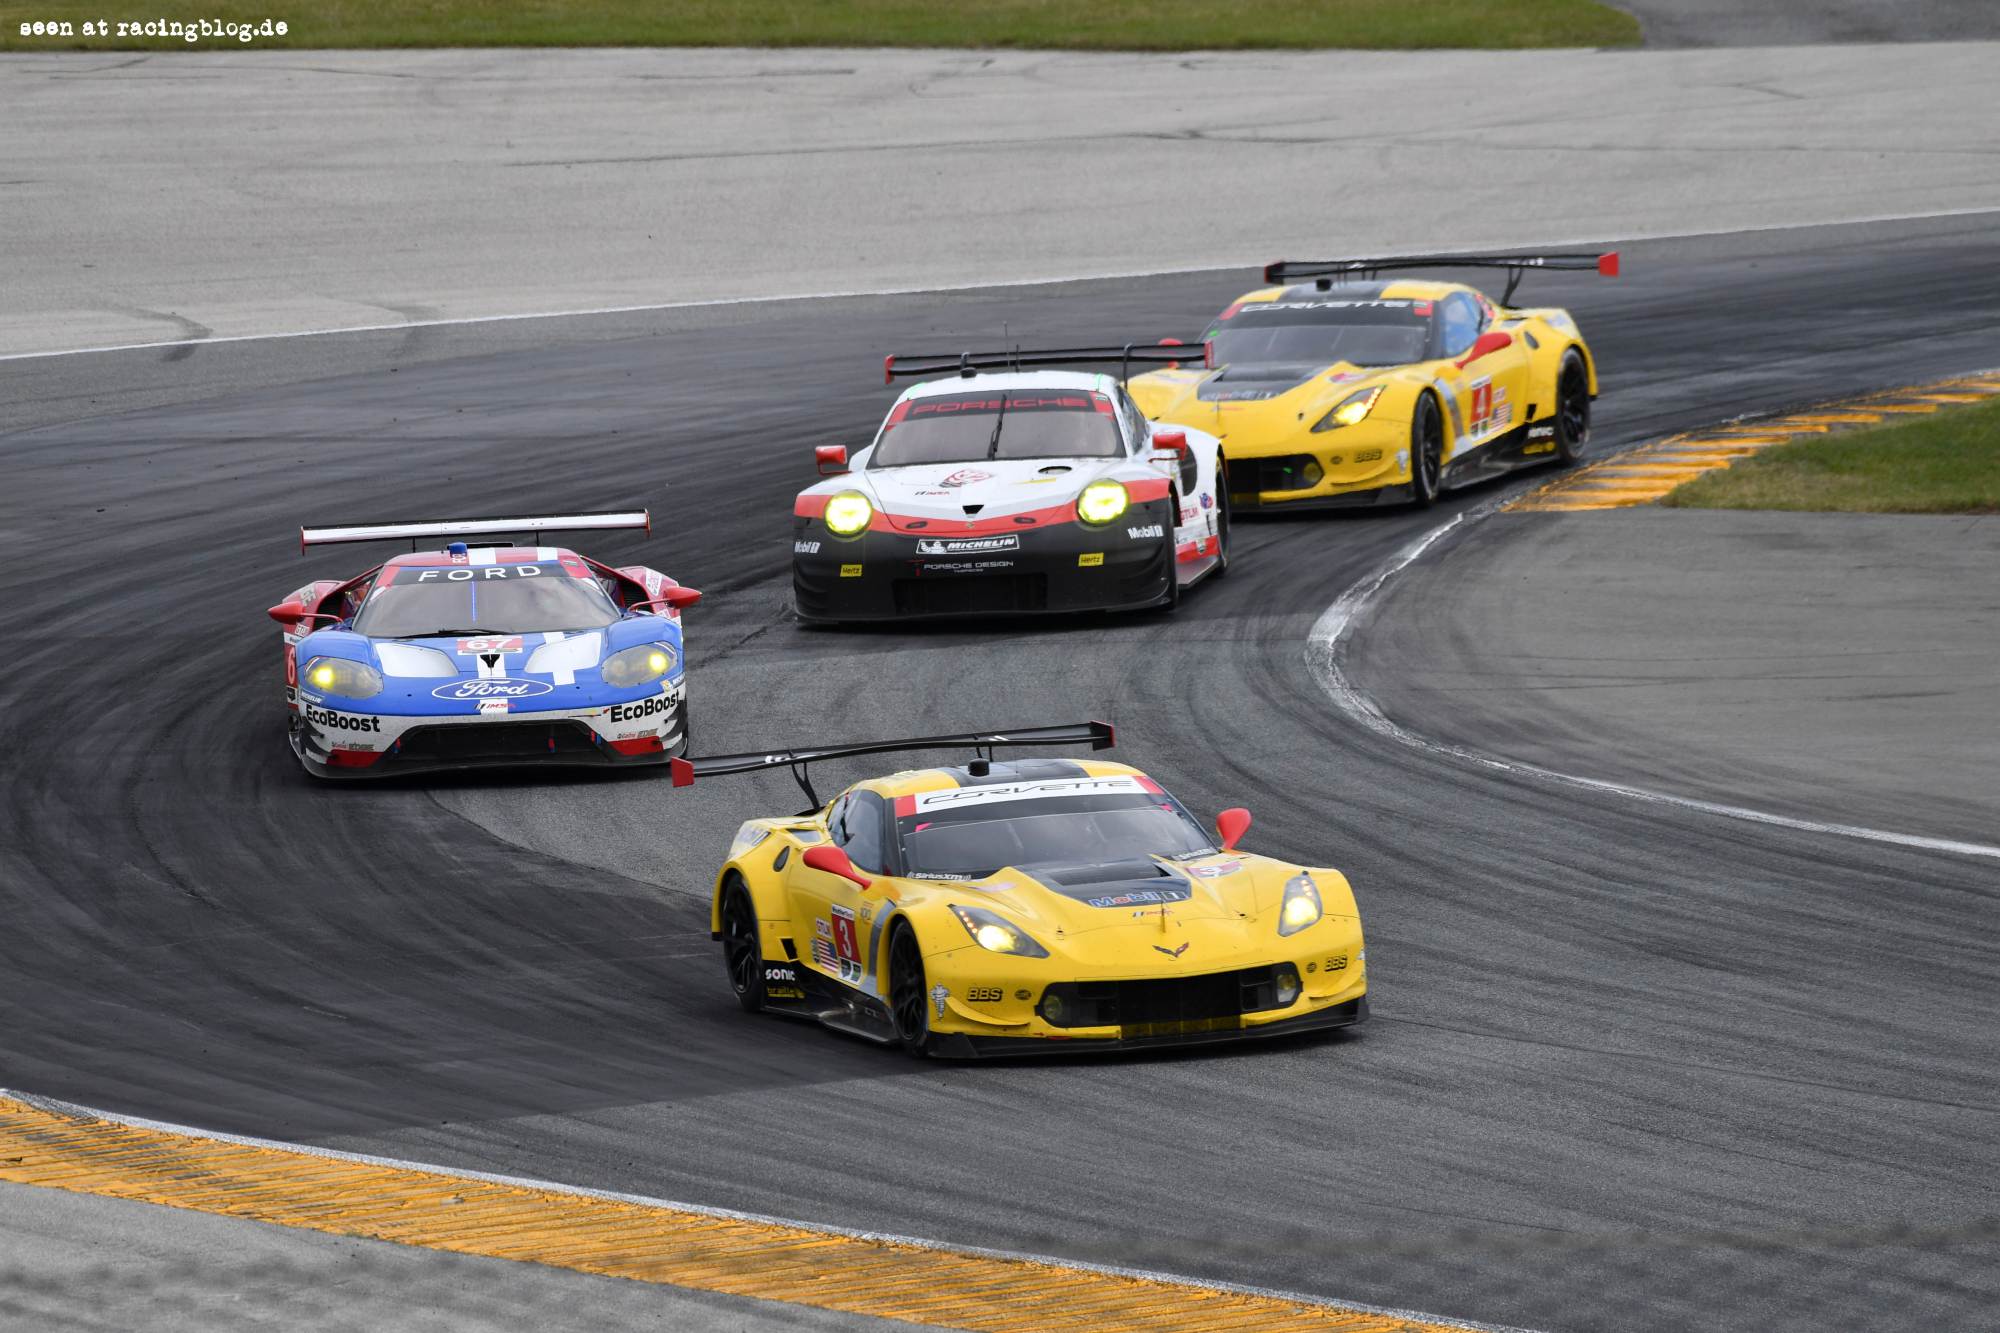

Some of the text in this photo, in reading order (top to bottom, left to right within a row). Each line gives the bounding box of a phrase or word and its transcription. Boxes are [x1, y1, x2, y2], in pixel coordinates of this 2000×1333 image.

[912, 397, 1088, 415] PORSCHE
[1127, 526, 1154, 539] Mobil
[947, 538, 1015, 550] MICHELIN
[924, 560, 1014, 570] PORSCHE DESIGN
[1081, 555, 1100, 563] Hertz
[418, 565, 541, 582] FORD
[842, 566, 860, 575] Hertz
[466, 638, 512, 650] 67
[455, 680, 528, 698] Ford
[611, 689, 680, 723] EcoBoost
[306, 703, 381, 733] EcoBoost
[923, 780, 1133, 805] CORVETTE
[1087, 891, 1161, 908] Mobil
[839, 920, 852, 958] 3
[1325, 955, 1348, 972] BBS
[967, 987, 1002, 1001] BBS
